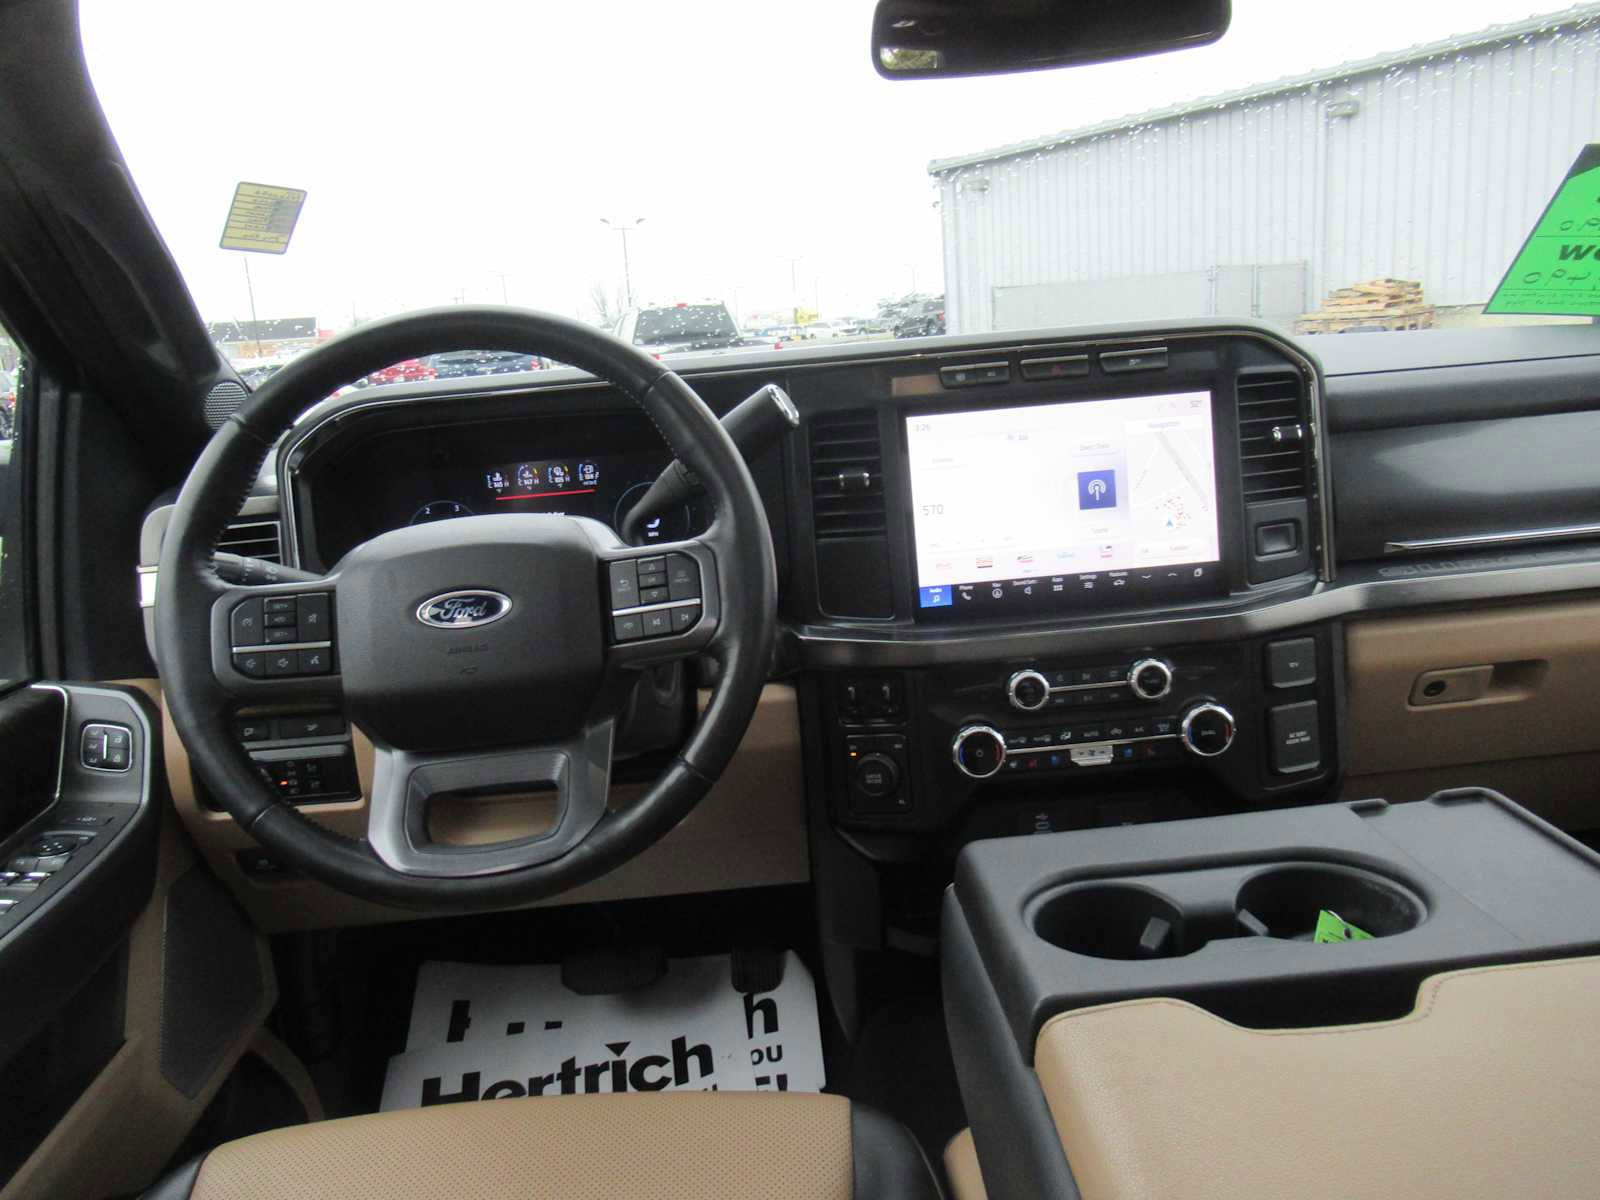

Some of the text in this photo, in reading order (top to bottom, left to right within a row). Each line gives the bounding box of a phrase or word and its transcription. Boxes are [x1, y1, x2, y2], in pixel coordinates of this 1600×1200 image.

[922, 503, 944, 516] 570
[440, 597, 488, 620] Ford
[750, 1044, 783, 1066] ou
